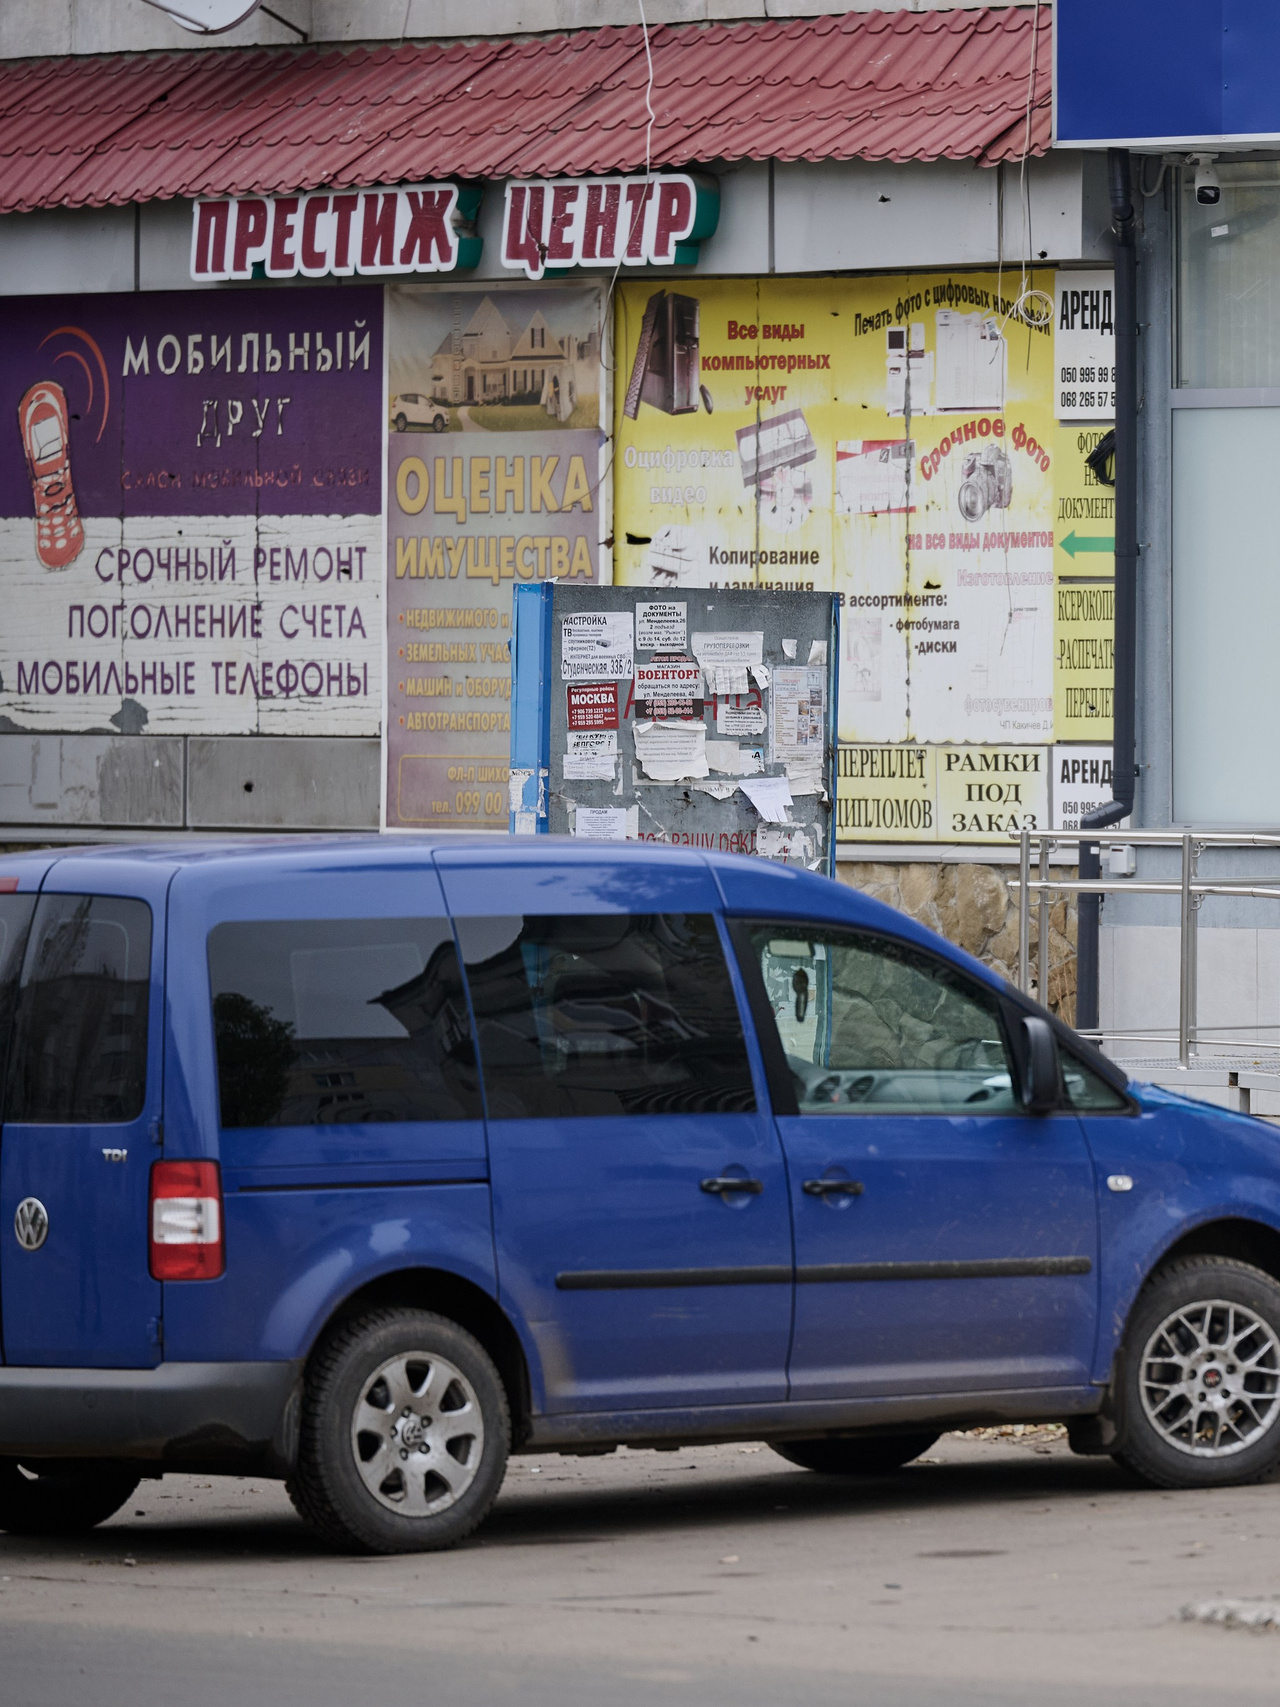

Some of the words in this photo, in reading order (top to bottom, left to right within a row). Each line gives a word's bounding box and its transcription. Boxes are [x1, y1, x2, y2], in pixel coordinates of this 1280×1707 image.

[193, 188, 457, 276] ПРЕСТИЖ
[505, 181, 692, 272] ЦЕНТР
[854, 308, 892, 337] Печать
[895, 293, 922, 325] фото
[924, 289, 931, 307] с
[932, 278, 990, 309] цифровых
[1060, 290, 1115, 335] АРЕНД
[728, 320, 759, 340] Все
[762, 324, 804, 341] виды
[122, 319, 371, 376] МОБИЛЬНЫЙ
[702, 354, 831, 374] компьютерных
[1061, 367, 1077, 383] 050
[1080, 367, 1095, 383] 995
[1098, 367, 1108, 383] 99
[745, 385, 787, 405] услуг
[1061, 391, 1077, 407] 068
[1080, 391, 1095, 407] 265
[1098, 391, 1108, 407] 57
[197, 397, 291, 448] ДРУГ
[624, 445, 734, 473] Оцифровка
[921, 417, 1006, 481] Срочное
[396, 454, 594, 524] ОЦЕНКА
[650, 485, 708, 507] видео
[908, 533, 922, 549] на
[926, 533, 945, 550] все
[949, 532, 980, 552] виды
[983, 531, 1054, 553] документов
[95, 540, 236, 582] СРОЧНЫЙ
[254, 546, 367, 582] РЕМОНТ
[395, 534, 593, 586] ИМУЩЕСТВА
[709, 546, 819, 568] Копирование
[957, 569, 1053, 586] Изготовление
[849, 593, 948, 610] ассортименте:
[279, 604, 367, 639] СЧЕТА
[406, 608, 498, 632] НЕДВИЖИМОГО
[563, 614, 607, 626] НАСТРОЙКА
[895, 618, 960, 633] фотобумага
[564, 628, 572, 637] ТВ
[406, 643, 477, 663] ЗЕМЕЛЬНЫХ
[17, 660, 196, 696] МОБИЛЬНЫЕ
[211, 659, 368, 697] ТЕЛЕФОНЫ
[637, 669, 700, 680] ВОЕНТОРГ
[406, 677, 452, 697] МАШИН
[455, 682, 463, 697] и
[571, 693, 615, 705] МОСКВА
[964, 695, 1053, 716] фотосувениров
[406, 711, 511, 732] АВТОТРАНСПОРТА
[837, 749, 927, 778] ПЕРЕПЛЕТ
[944, 753, 1041, 772] РАМКИ
[432, 800, 451, 814] тел.
[456, 791, 480, 815] 099
[484, 792, 502, 815] 00
[965, 783, 1022, 806] ПОД
[1063, 801, 1078, 814] 050
[952, 813, 1037, 832] ЗАКАЗ
[102, 1148, 128, 1162] TDI
